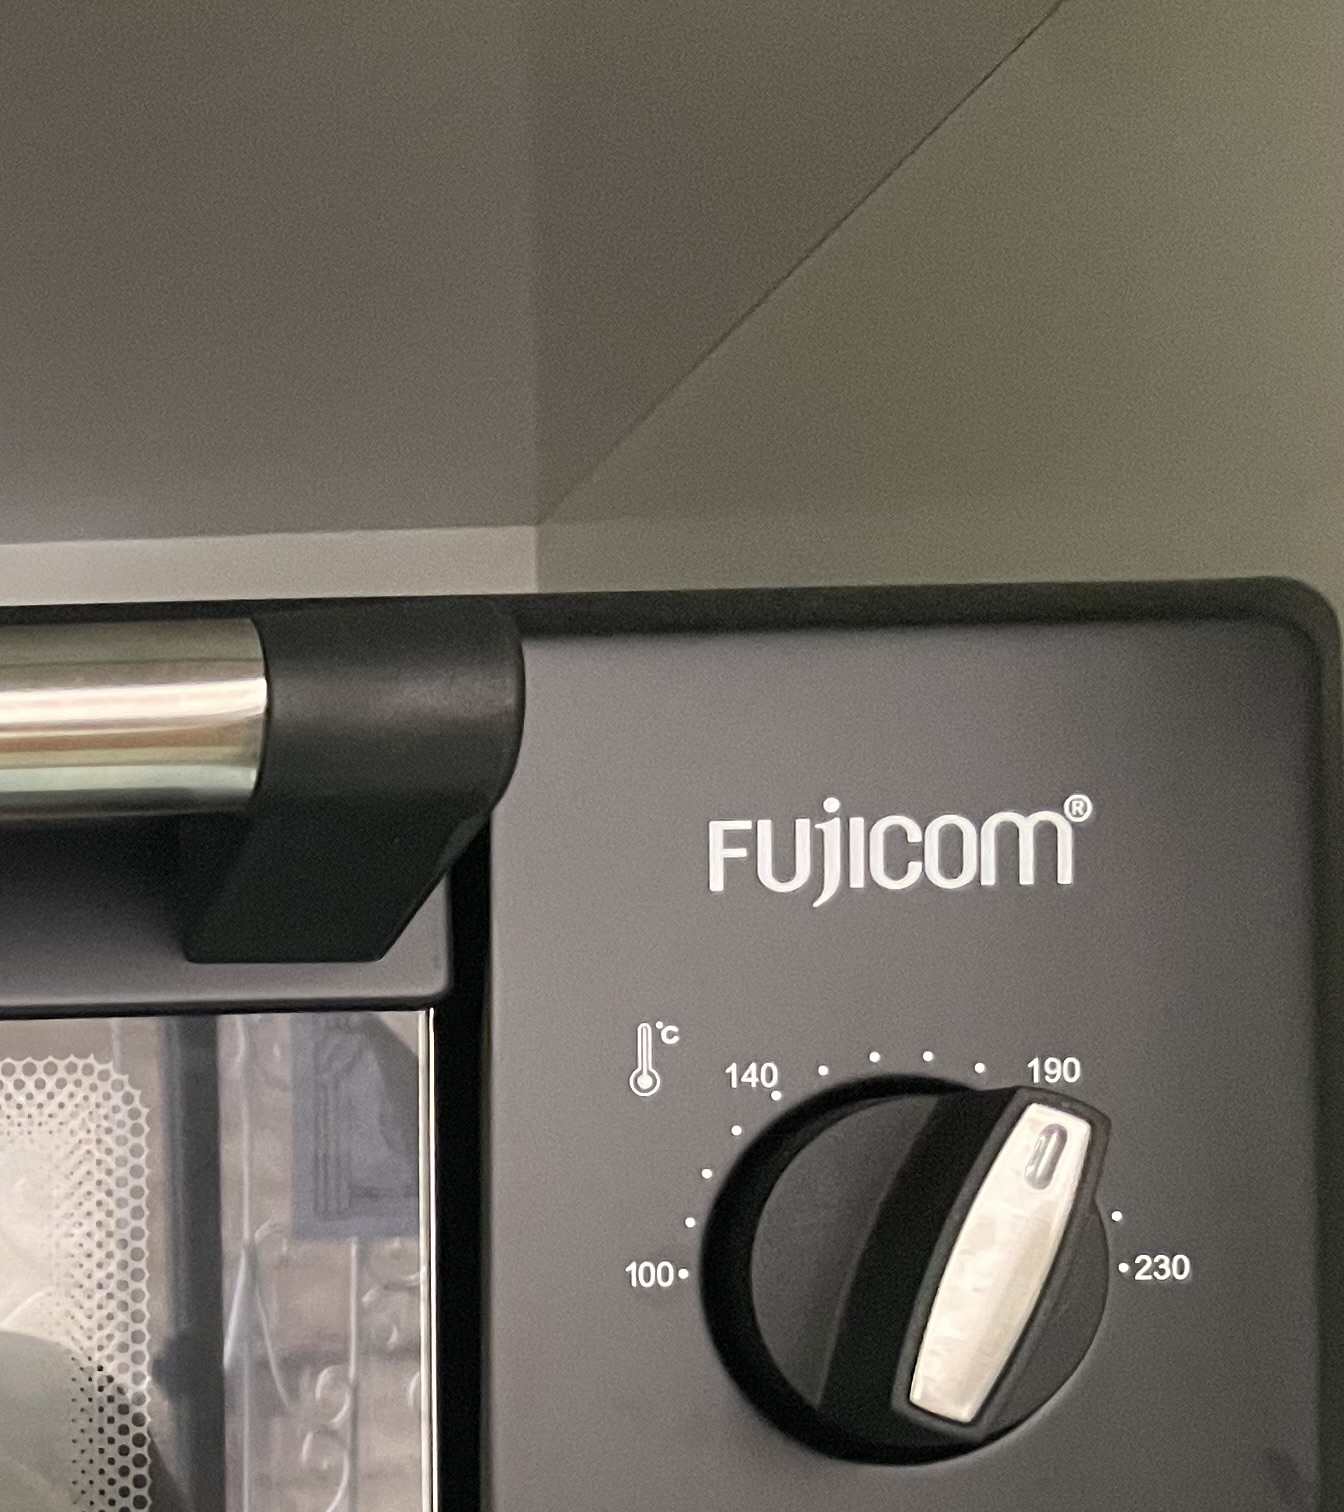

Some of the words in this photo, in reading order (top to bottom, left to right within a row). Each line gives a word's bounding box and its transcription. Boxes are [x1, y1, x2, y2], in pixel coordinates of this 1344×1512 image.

[725, 1062, 779, 1089] 140
[1027, 1056, 1081, 1084] 190
[625, 1261, 675, 1288] 100
[1134, 1254, 1191, 1281] 230
